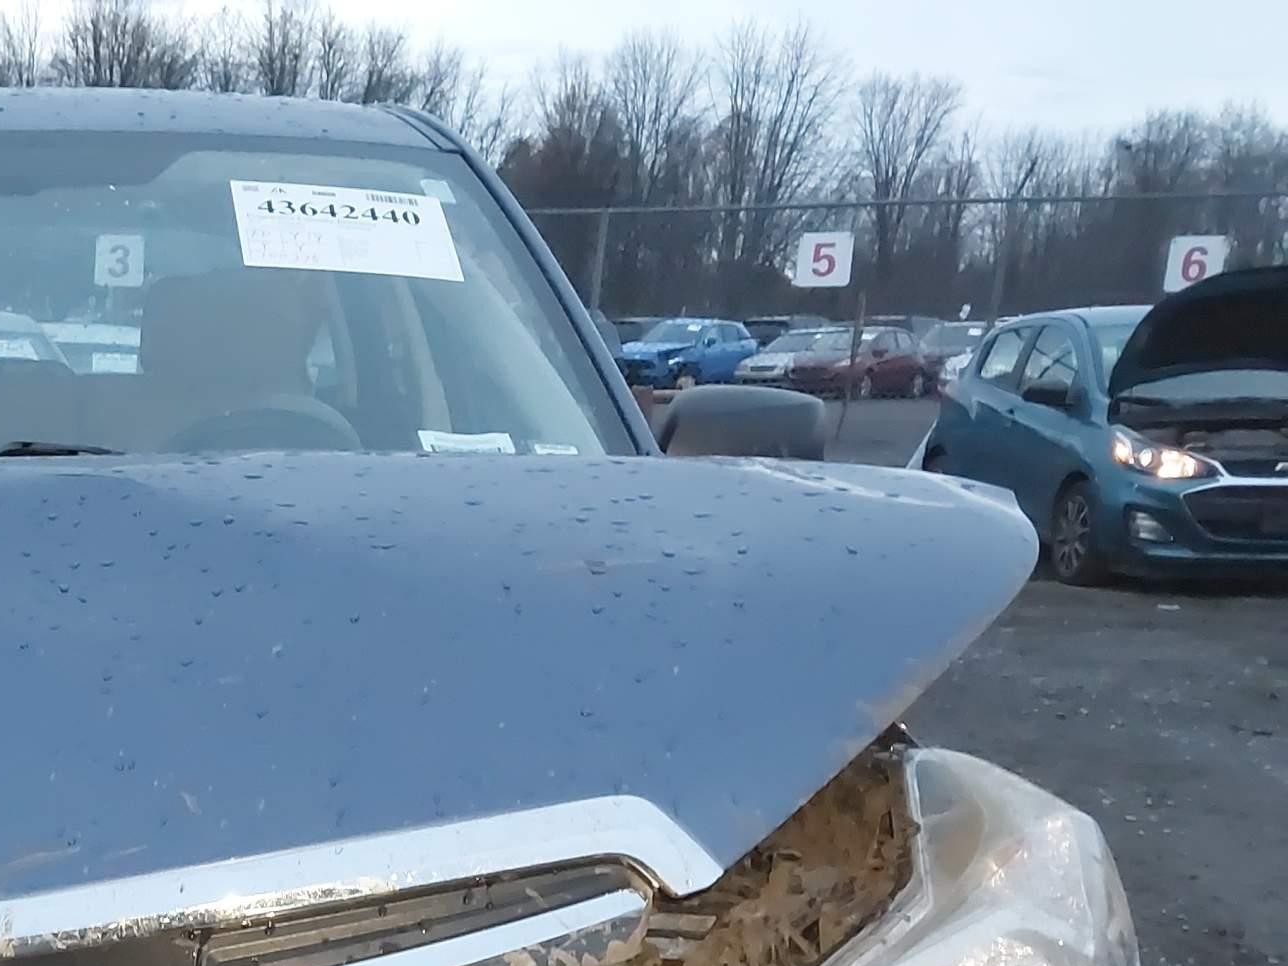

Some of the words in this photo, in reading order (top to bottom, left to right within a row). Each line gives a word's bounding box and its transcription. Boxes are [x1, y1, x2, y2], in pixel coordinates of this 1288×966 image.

[257, 199, 421, 226] 43642440
[107, 244, 131, 279] 3
[812, 242, 837, 278] 5
[1181, 246, 1209, 282] 6
